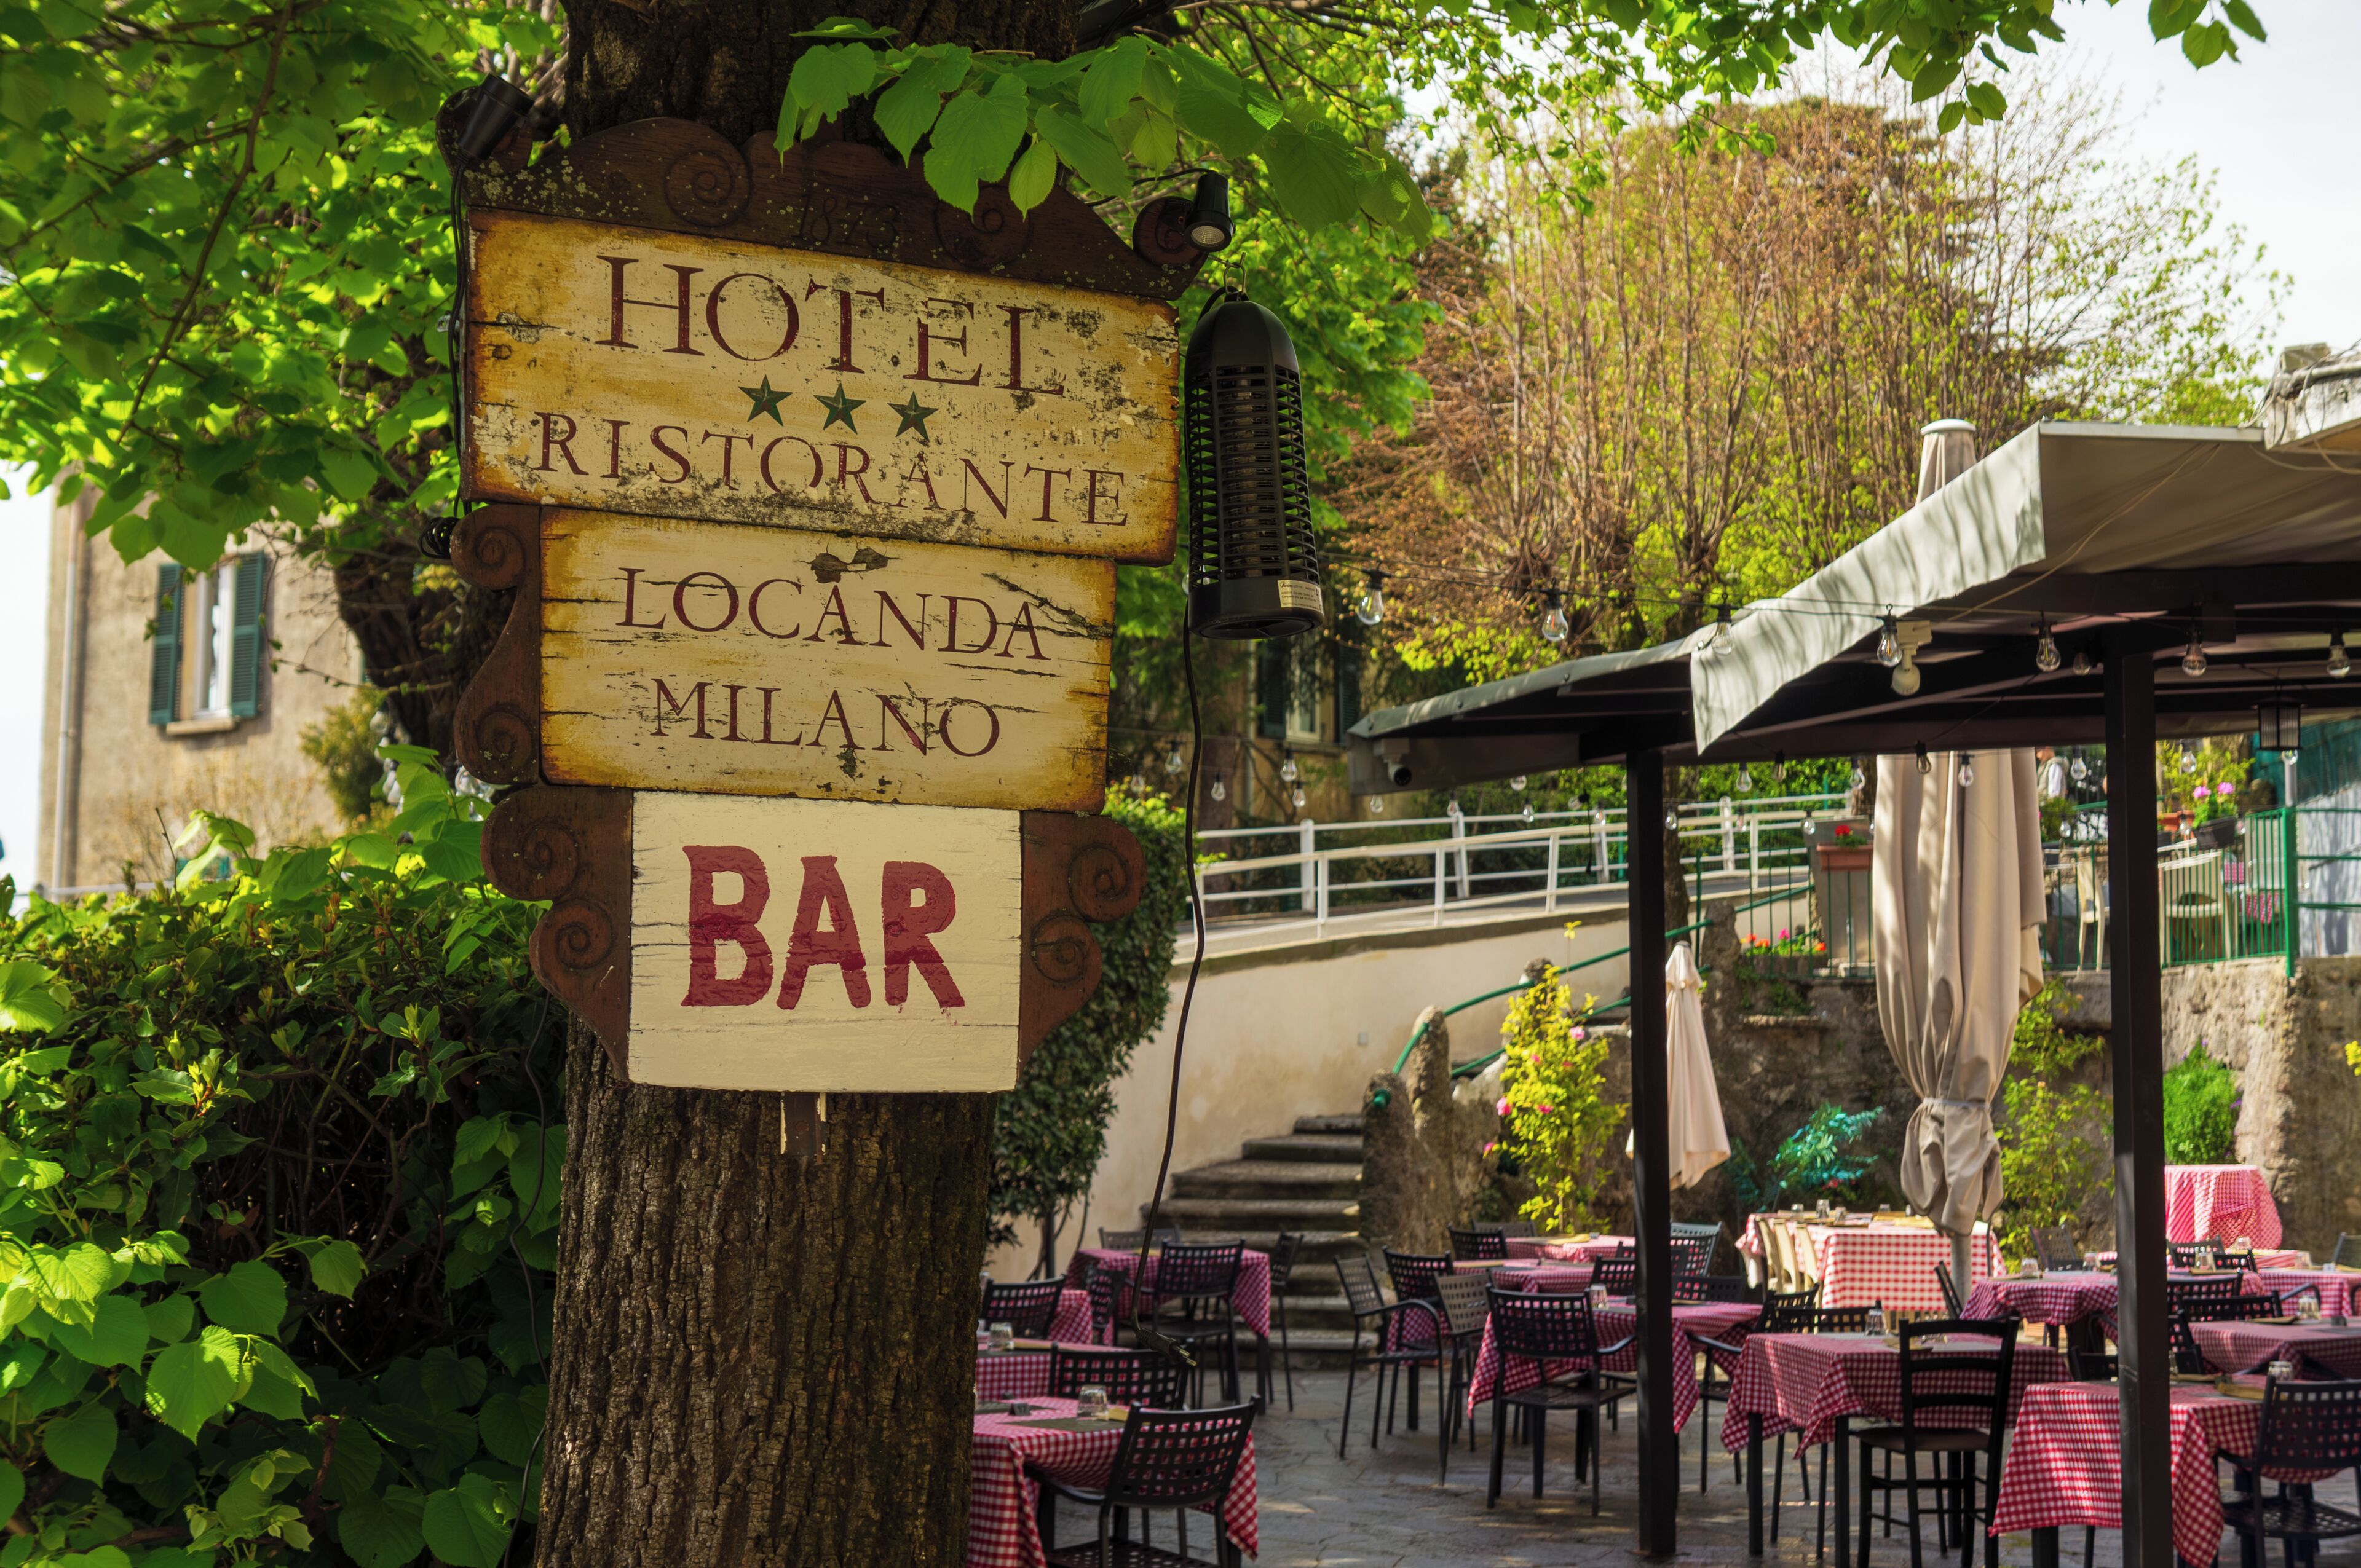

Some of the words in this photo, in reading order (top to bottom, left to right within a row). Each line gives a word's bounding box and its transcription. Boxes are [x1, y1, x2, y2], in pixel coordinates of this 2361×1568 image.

[791, 193, 900, 250] 1873
[596, 254, 1066, 396] HOTEL
[533, 412, 1128, 527] RISTORANTE
[615, 567, 1051, 660] LOCANDA
[649, 677, 1001, 756] MILANO
[681, 845, 965, 1010] BAR
